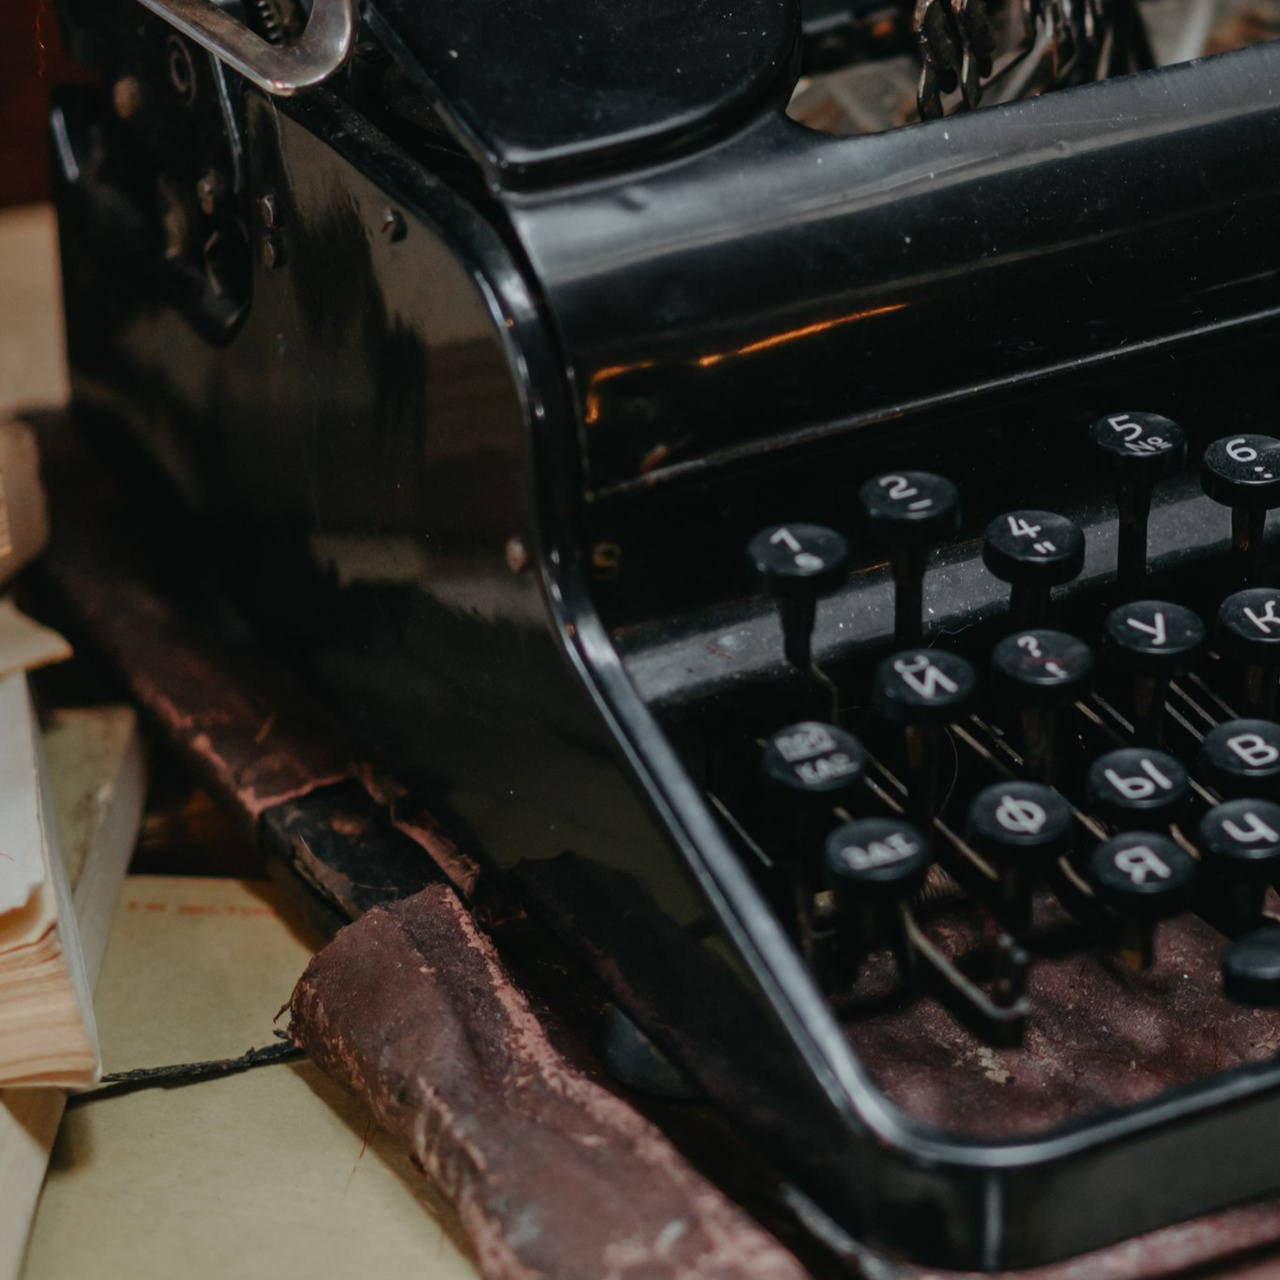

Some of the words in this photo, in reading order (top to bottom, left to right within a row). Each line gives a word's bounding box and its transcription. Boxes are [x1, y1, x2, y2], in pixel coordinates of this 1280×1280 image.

[1108, 414, 1142, 442] 5
[1225, 438, 1257, 463] 6
[879, 475, 918, 500] 2
[1007, 516, 1041, 538] 4
[893, 654, 960, 700] Й
[1226, 733, 1280, 767] В
[1104, 758, 1174, 800] Ы
[995, 795, 1046, 835] Ф
[1114, 845, 1172, 885] Я
